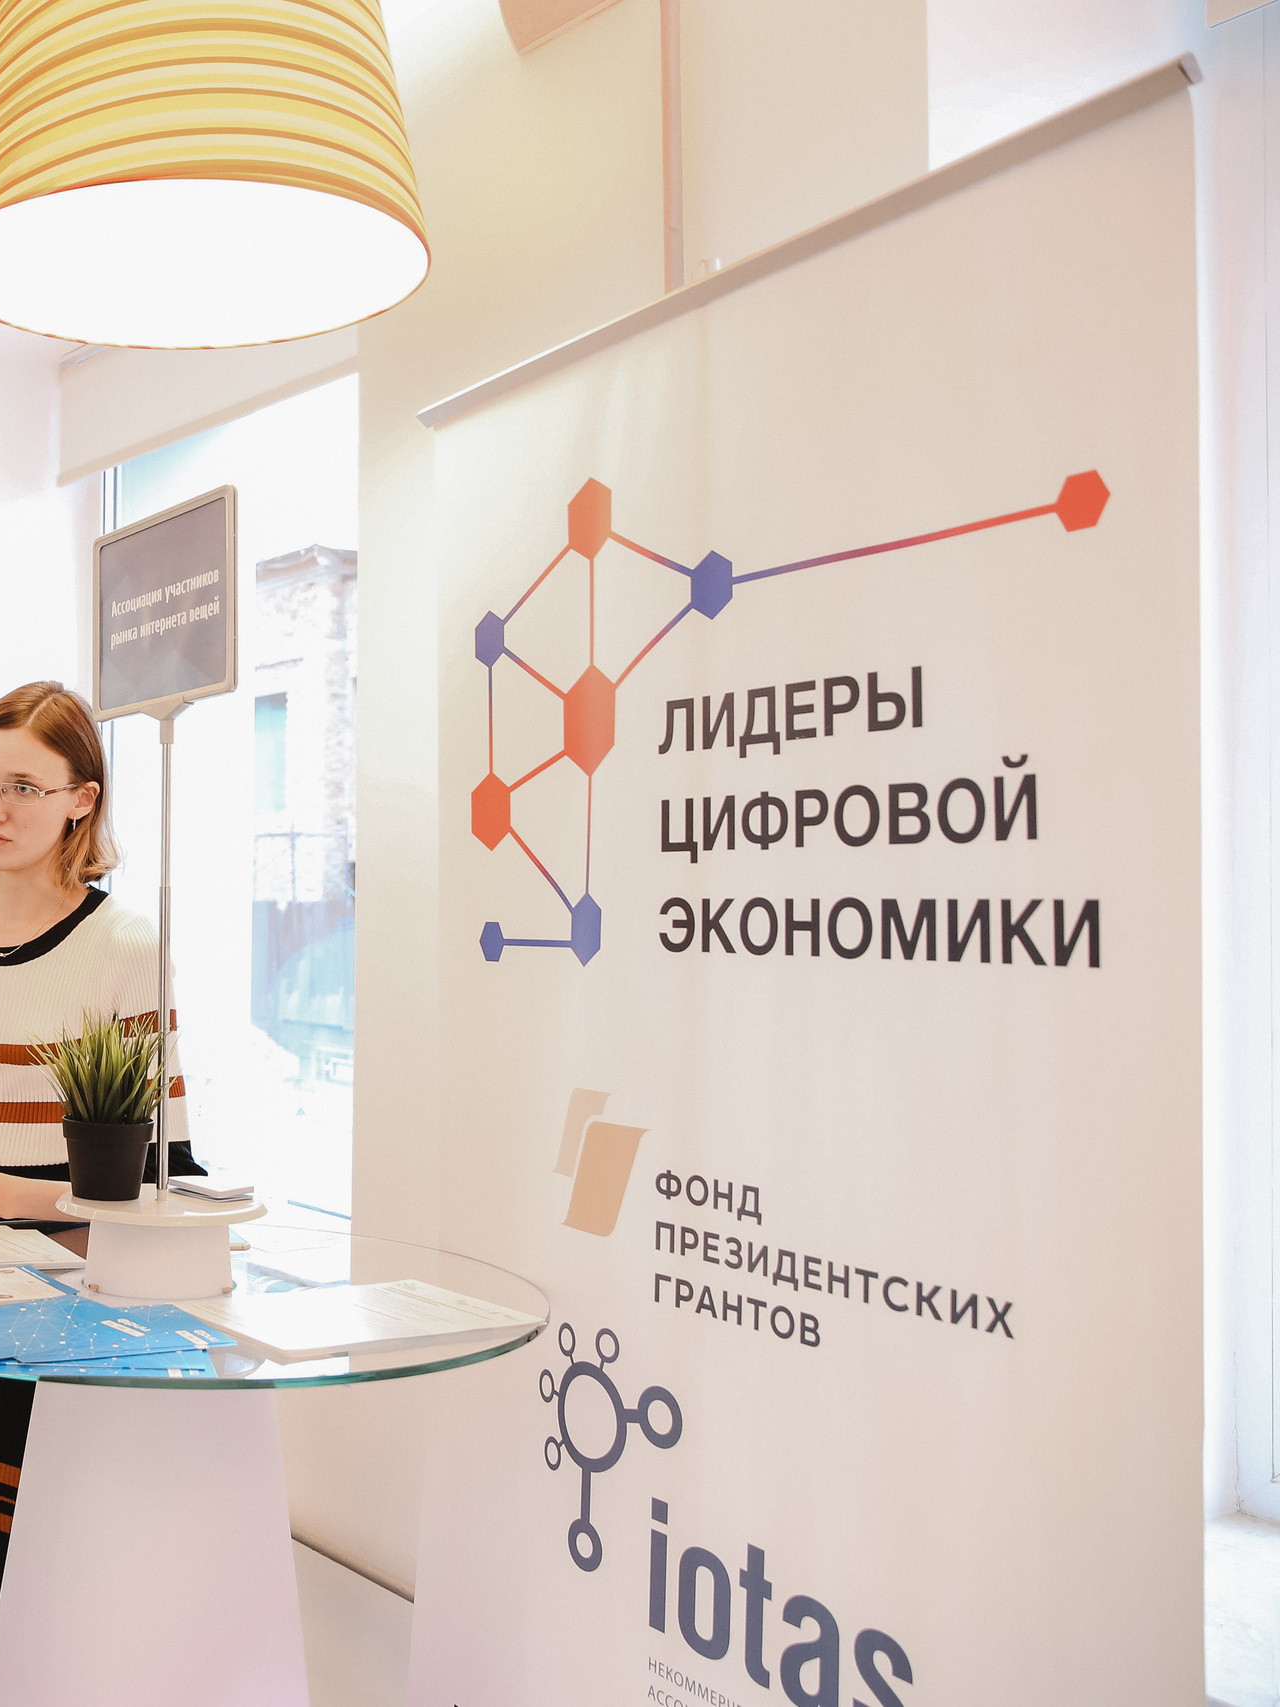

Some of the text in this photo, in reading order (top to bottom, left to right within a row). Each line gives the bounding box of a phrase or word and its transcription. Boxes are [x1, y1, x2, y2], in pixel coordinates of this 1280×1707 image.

[110, 595, 220, 650] рынка интернета вещей
[111, 569, 219, 618] Ассоциация участников
[658, 665, 924, 758] ЛИДЕРЫ
[660, 754, 1038, 864] ЦИФРОВОЙ
[658, 896, 1101, 968] ЭКОНОМИКИ
[655, 1169, 762, 1225] ФОНД
[654, 1273, 821, 1347] ГРАНТОВ
[655, 1221, 1014, 1339] ПРЕЗИДЕНТСКИХ
[649, 1496, 913, 1707] iotas
[648, 1656, 744, 1707] НЕКОММЕР
